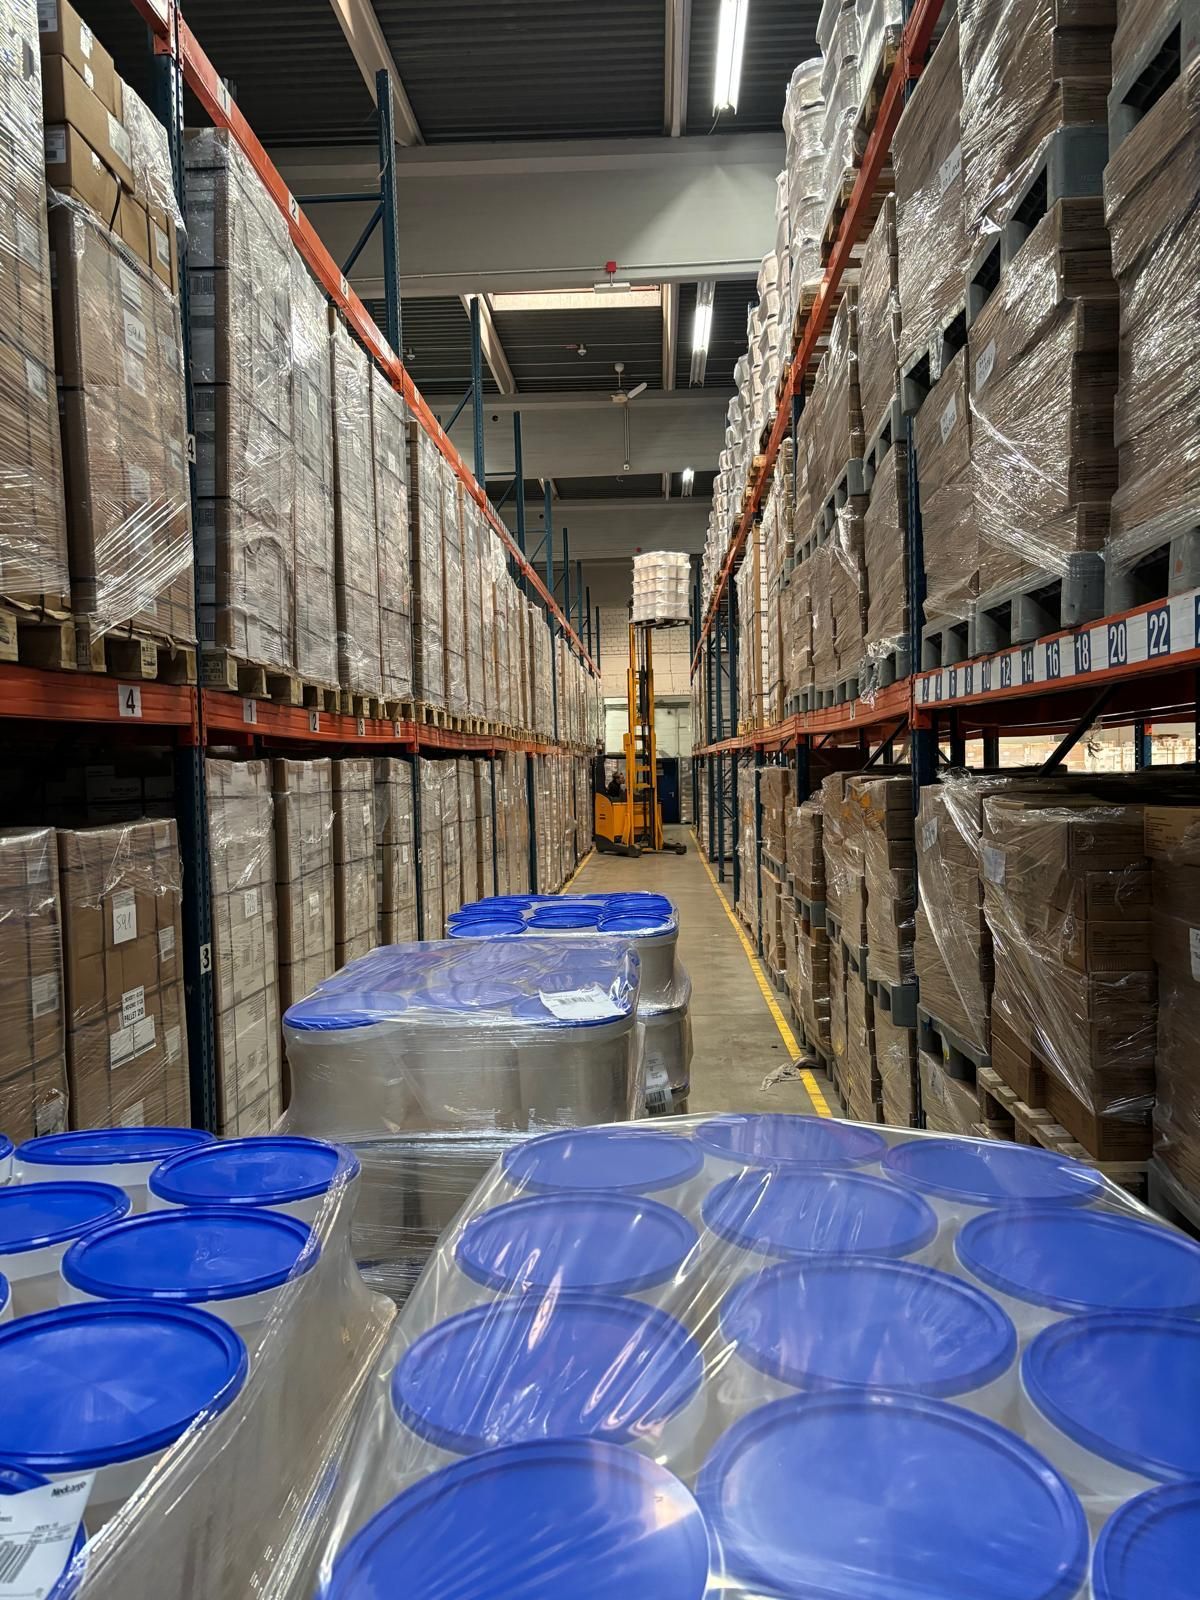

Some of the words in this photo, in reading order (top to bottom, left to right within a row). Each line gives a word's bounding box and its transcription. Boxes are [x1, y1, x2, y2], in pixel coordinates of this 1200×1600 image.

[291, 199, 298, 220] 2
[187, 437, 194, 459] 4
[966, 668, 971, 693] 8
[982, 661, 991, 689] 10
[1002, 657, 1011, 686] 12
[1022, 650, 1033, 682] 14
[1047, 643, 1059, 676] 16
[1076, 634, 1090, 671] 18
[1109, 623, 1126, 664] 20
[1149, 610, 1168, 656] 22
[125, 688, 136, 714] 4
[247, 703, 253, 722] 1
[312, 713, 318, 731] 2
[202, 947, 210, 969] 3
